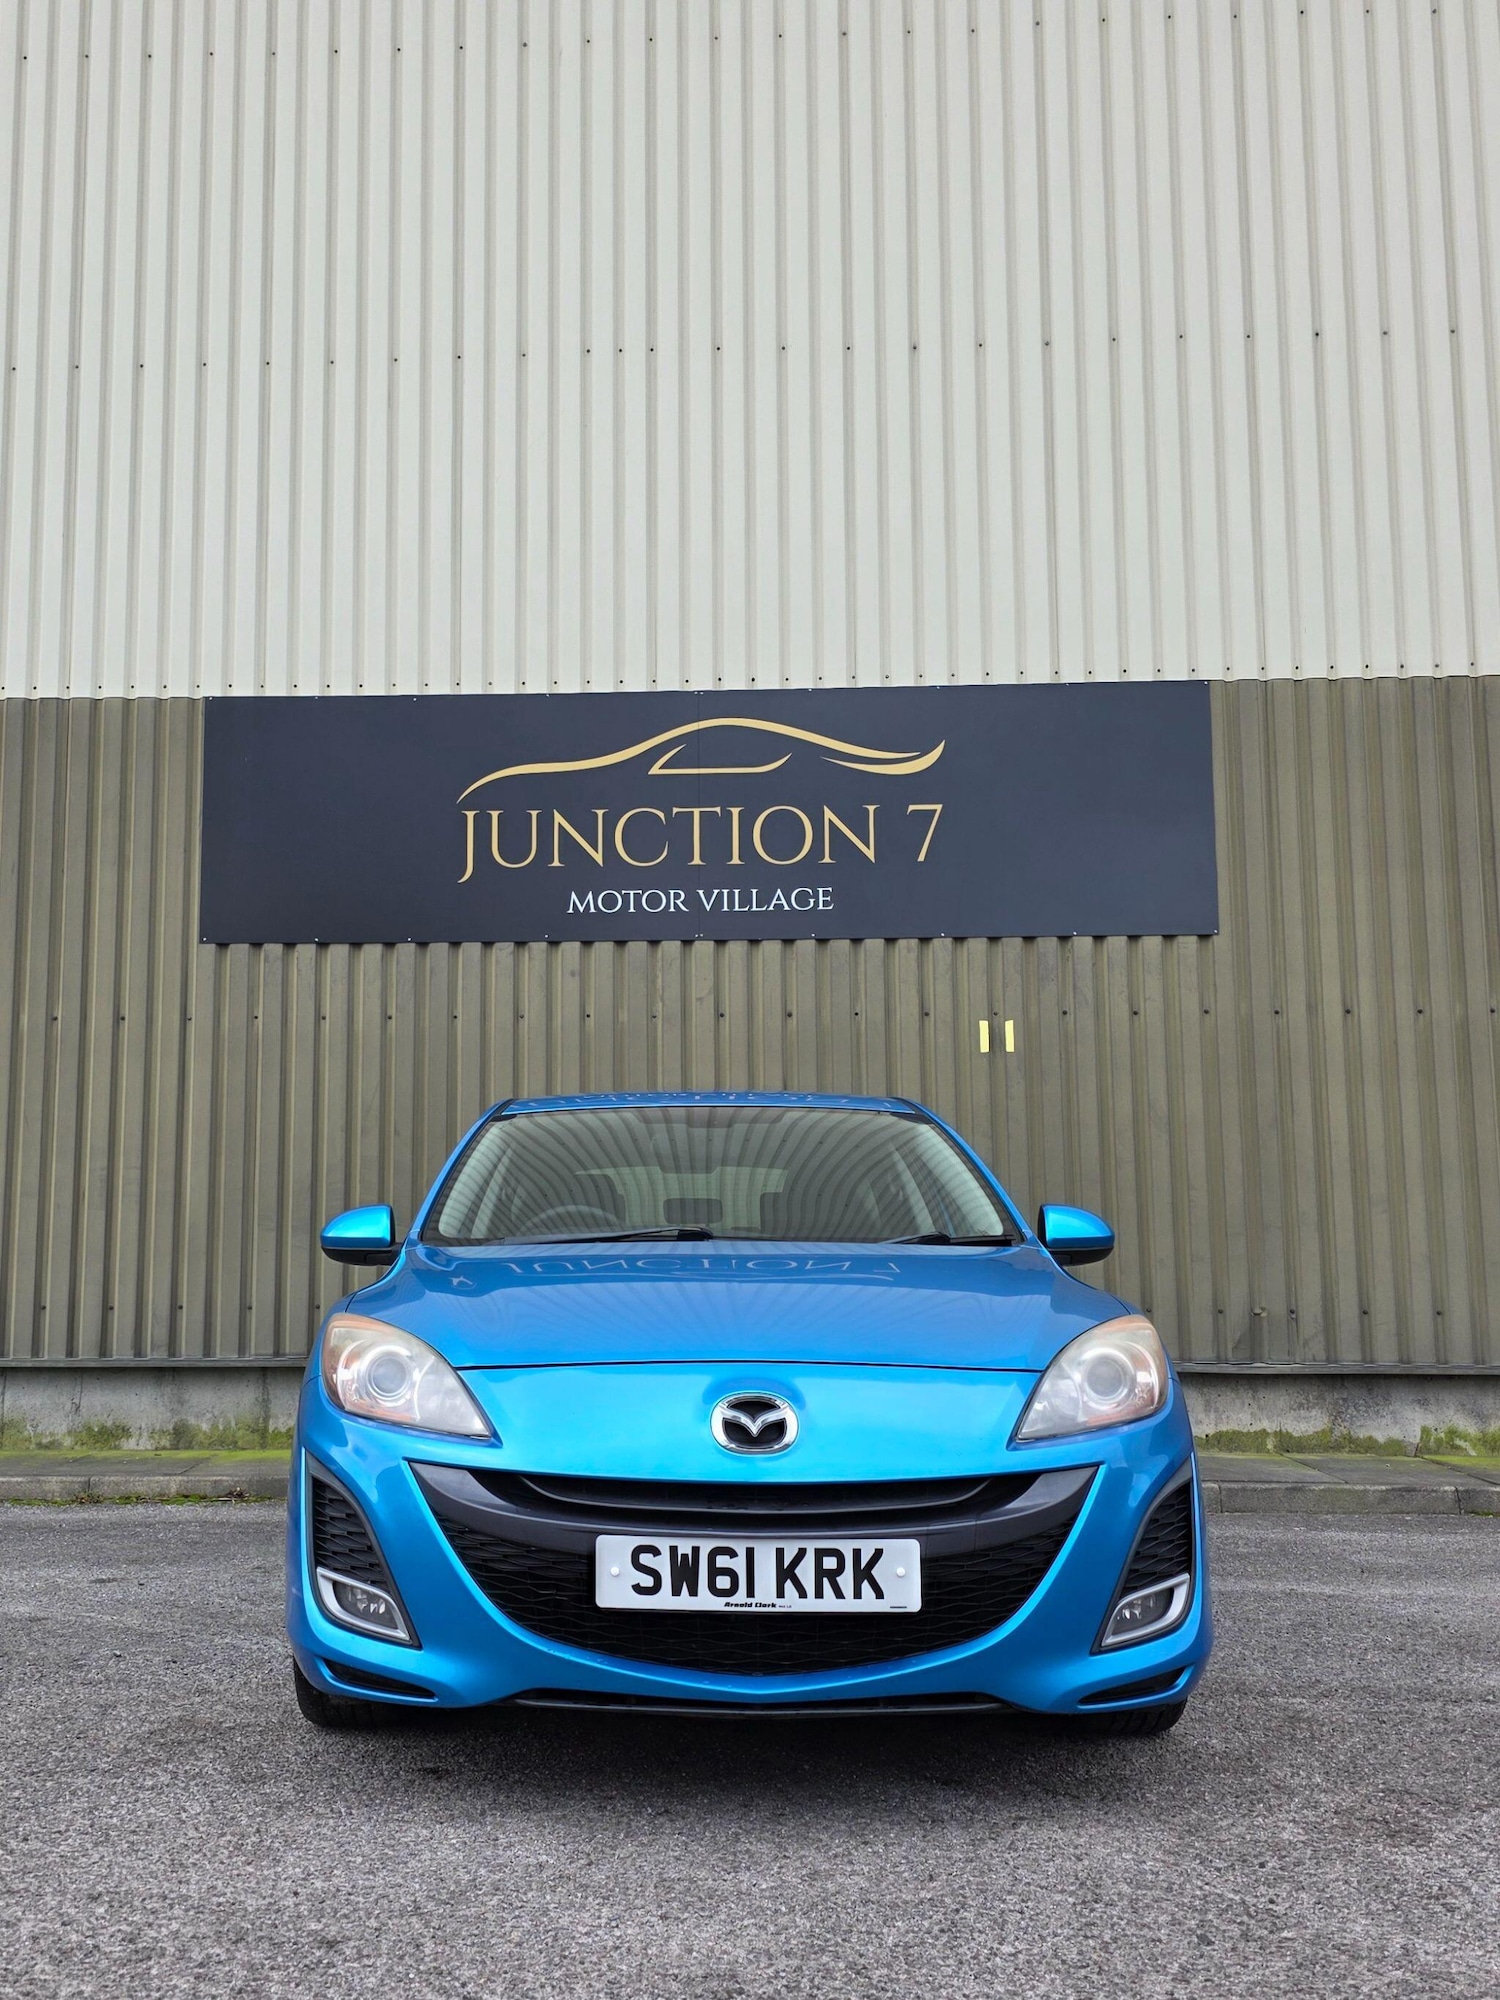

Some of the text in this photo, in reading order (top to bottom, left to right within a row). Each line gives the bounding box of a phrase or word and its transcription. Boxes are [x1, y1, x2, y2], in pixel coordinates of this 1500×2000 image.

[457, 803, 943, 884] JUNCTION 7
[566, 886, 835, 914] MOTOR VILLAGE
[630, 1544, 885, 1600] SW61 KRK
[723, 1601, 754, 1609] Arnold
